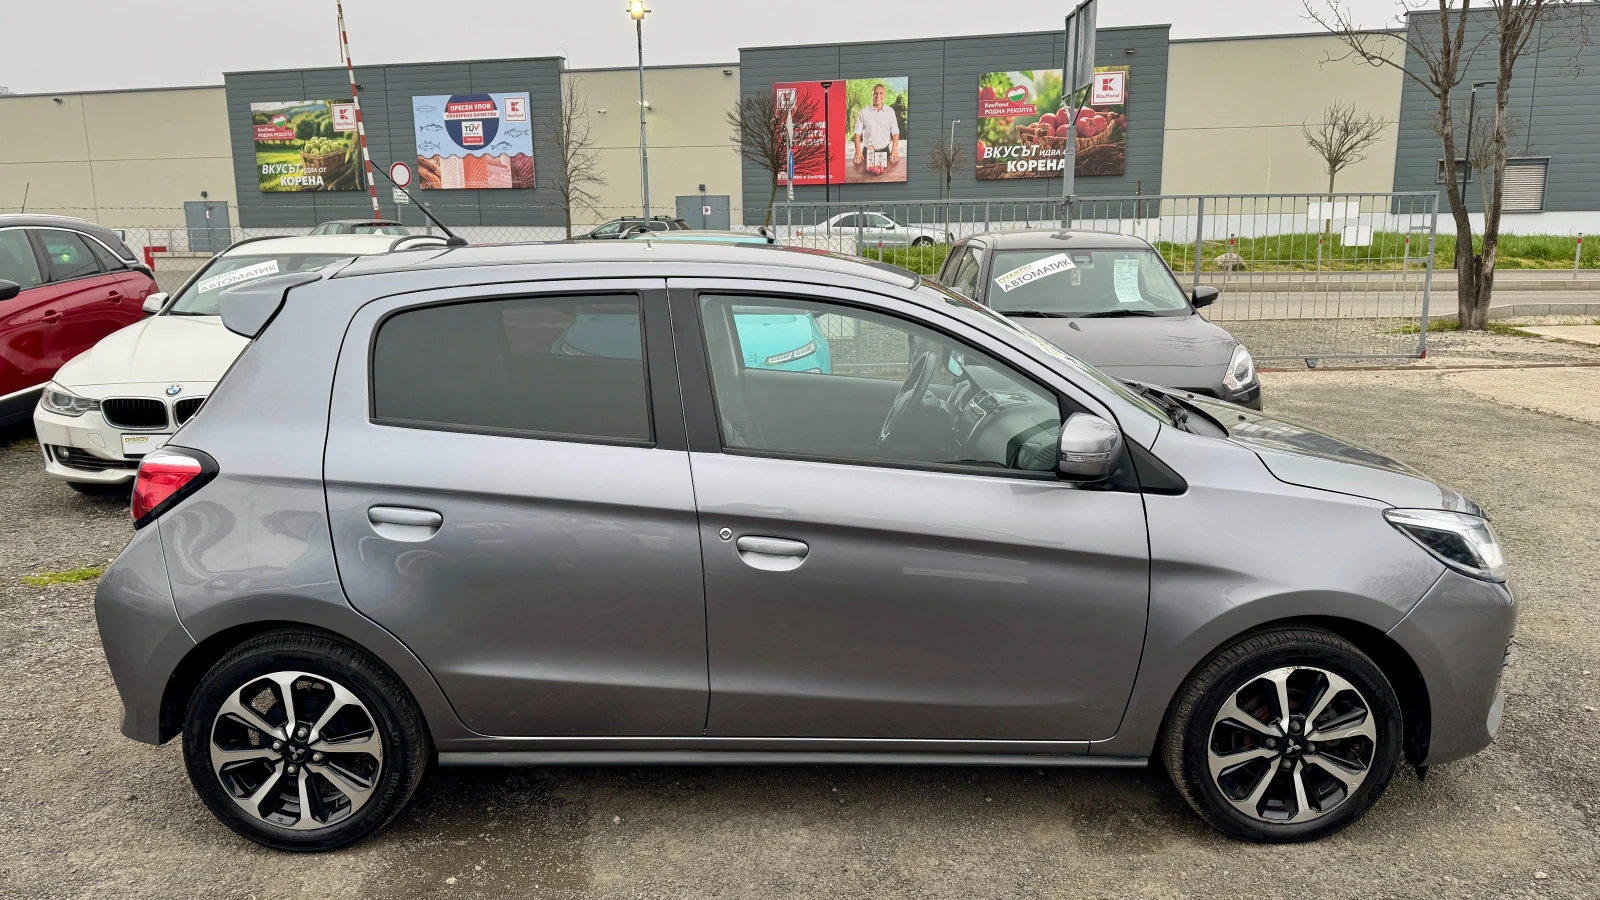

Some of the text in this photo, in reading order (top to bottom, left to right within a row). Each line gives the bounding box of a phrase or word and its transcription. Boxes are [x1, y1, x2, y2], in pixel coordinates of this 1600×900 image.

[450, 104, 473, 112] ПРЕСЕН
[983, 144, 1040, 159] ВКУСЪТ
[262, 163, 301, 175] ВКУСЪТ
[1006, 159, 1065, 173] КОРЕНА
[280, 175, 325, 187] КОРЕНА
[200, 264, 277, 293] АВТОМАТИК
[1004, 258, 1072, 292] АВТОМАТИК
[366, 771, 400, 823] BRAVURIS
